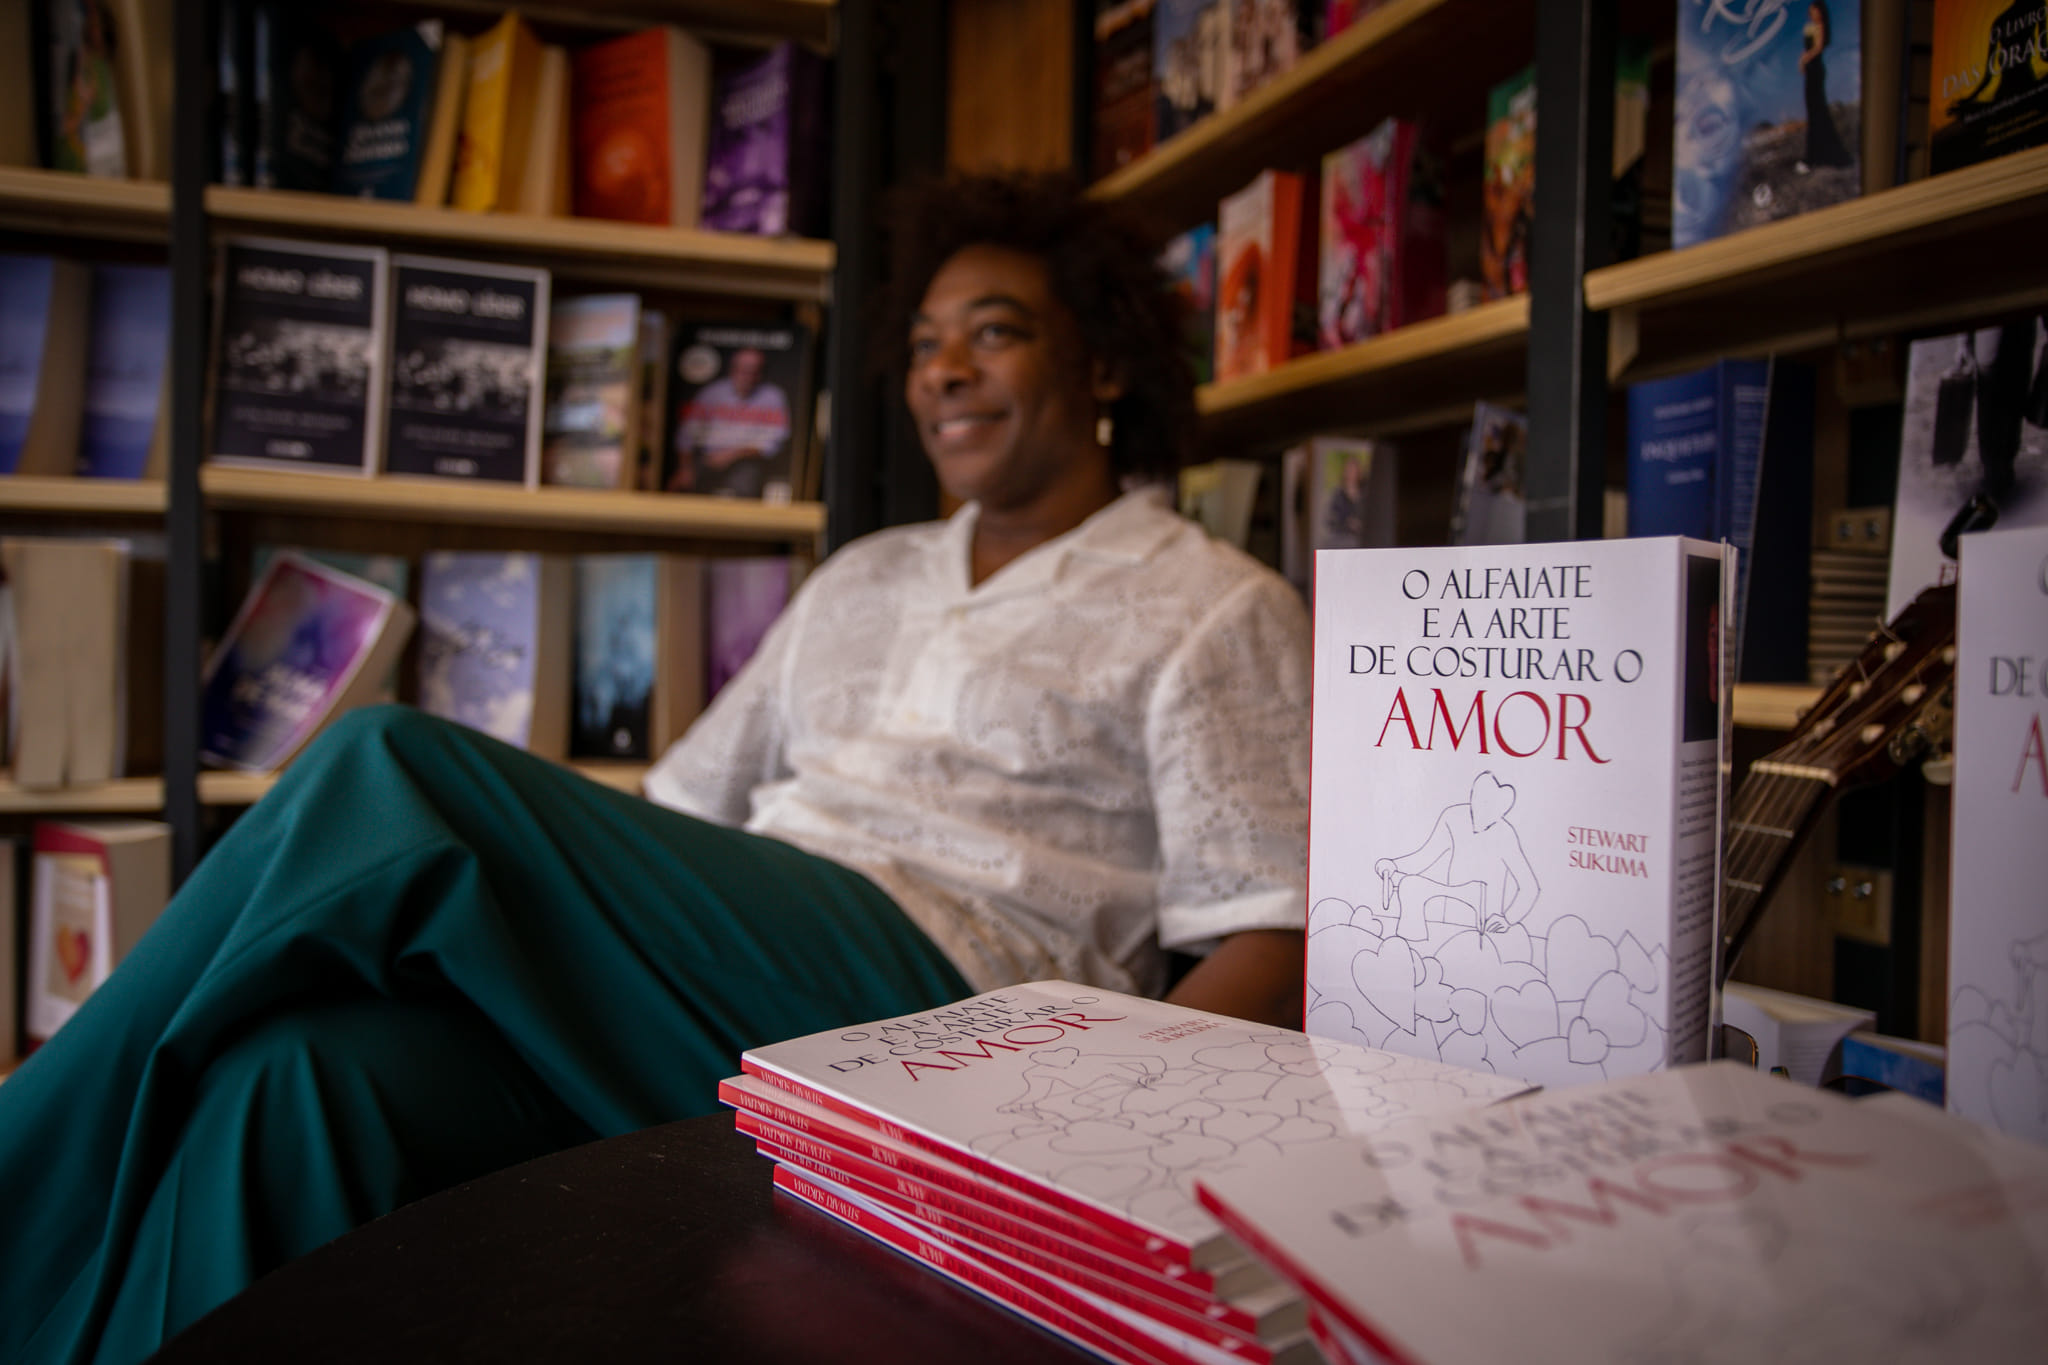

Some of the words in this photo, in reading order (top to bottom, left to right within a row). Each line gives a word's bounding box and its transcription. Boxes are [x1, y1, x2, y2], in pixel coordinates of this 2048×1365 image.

[1943, 63, 1981, 99] DAS
[1402, 569, 1430, 600] O
[1440, 565, 1593, 600] ALFAIATE
[1422, 607, 1441, 638] E
[1450, 608, 1474, 638] A
[1484, 607, 1571, 640] ARTE
[1349, 645, 1396, 675] DE
[1406, 646, 1604, 682] COSTURAR
[1614, 649, 1644, 683] O
[1373, 686, 1612, 764] AMOR
[1567, 825, 1650, 854] STEWART
[1568, 851, 1649, 879] SUKUMA
[828, 1053, 888, 1072] DE
[889, 1005, 1074, 1056] COSTURAR
[1071, 996, 1100, 1005] O
[841, 1032, 870, 1042] O
[880, 994, 1018, 1035] ALFAIATE
[878, 1035, 908, 1046] E
[912, 1030, 937, 1039] A
[943, 1006, 1023, 1031] ARTE
[1139, 1018, 1209, 1041] STEWART
[1157, 1022, 1229, 1044] SUKUMA
[901, 1013, 1128, 1082] AMOR
[1449, 1133, 1876, 1270] AMOR
